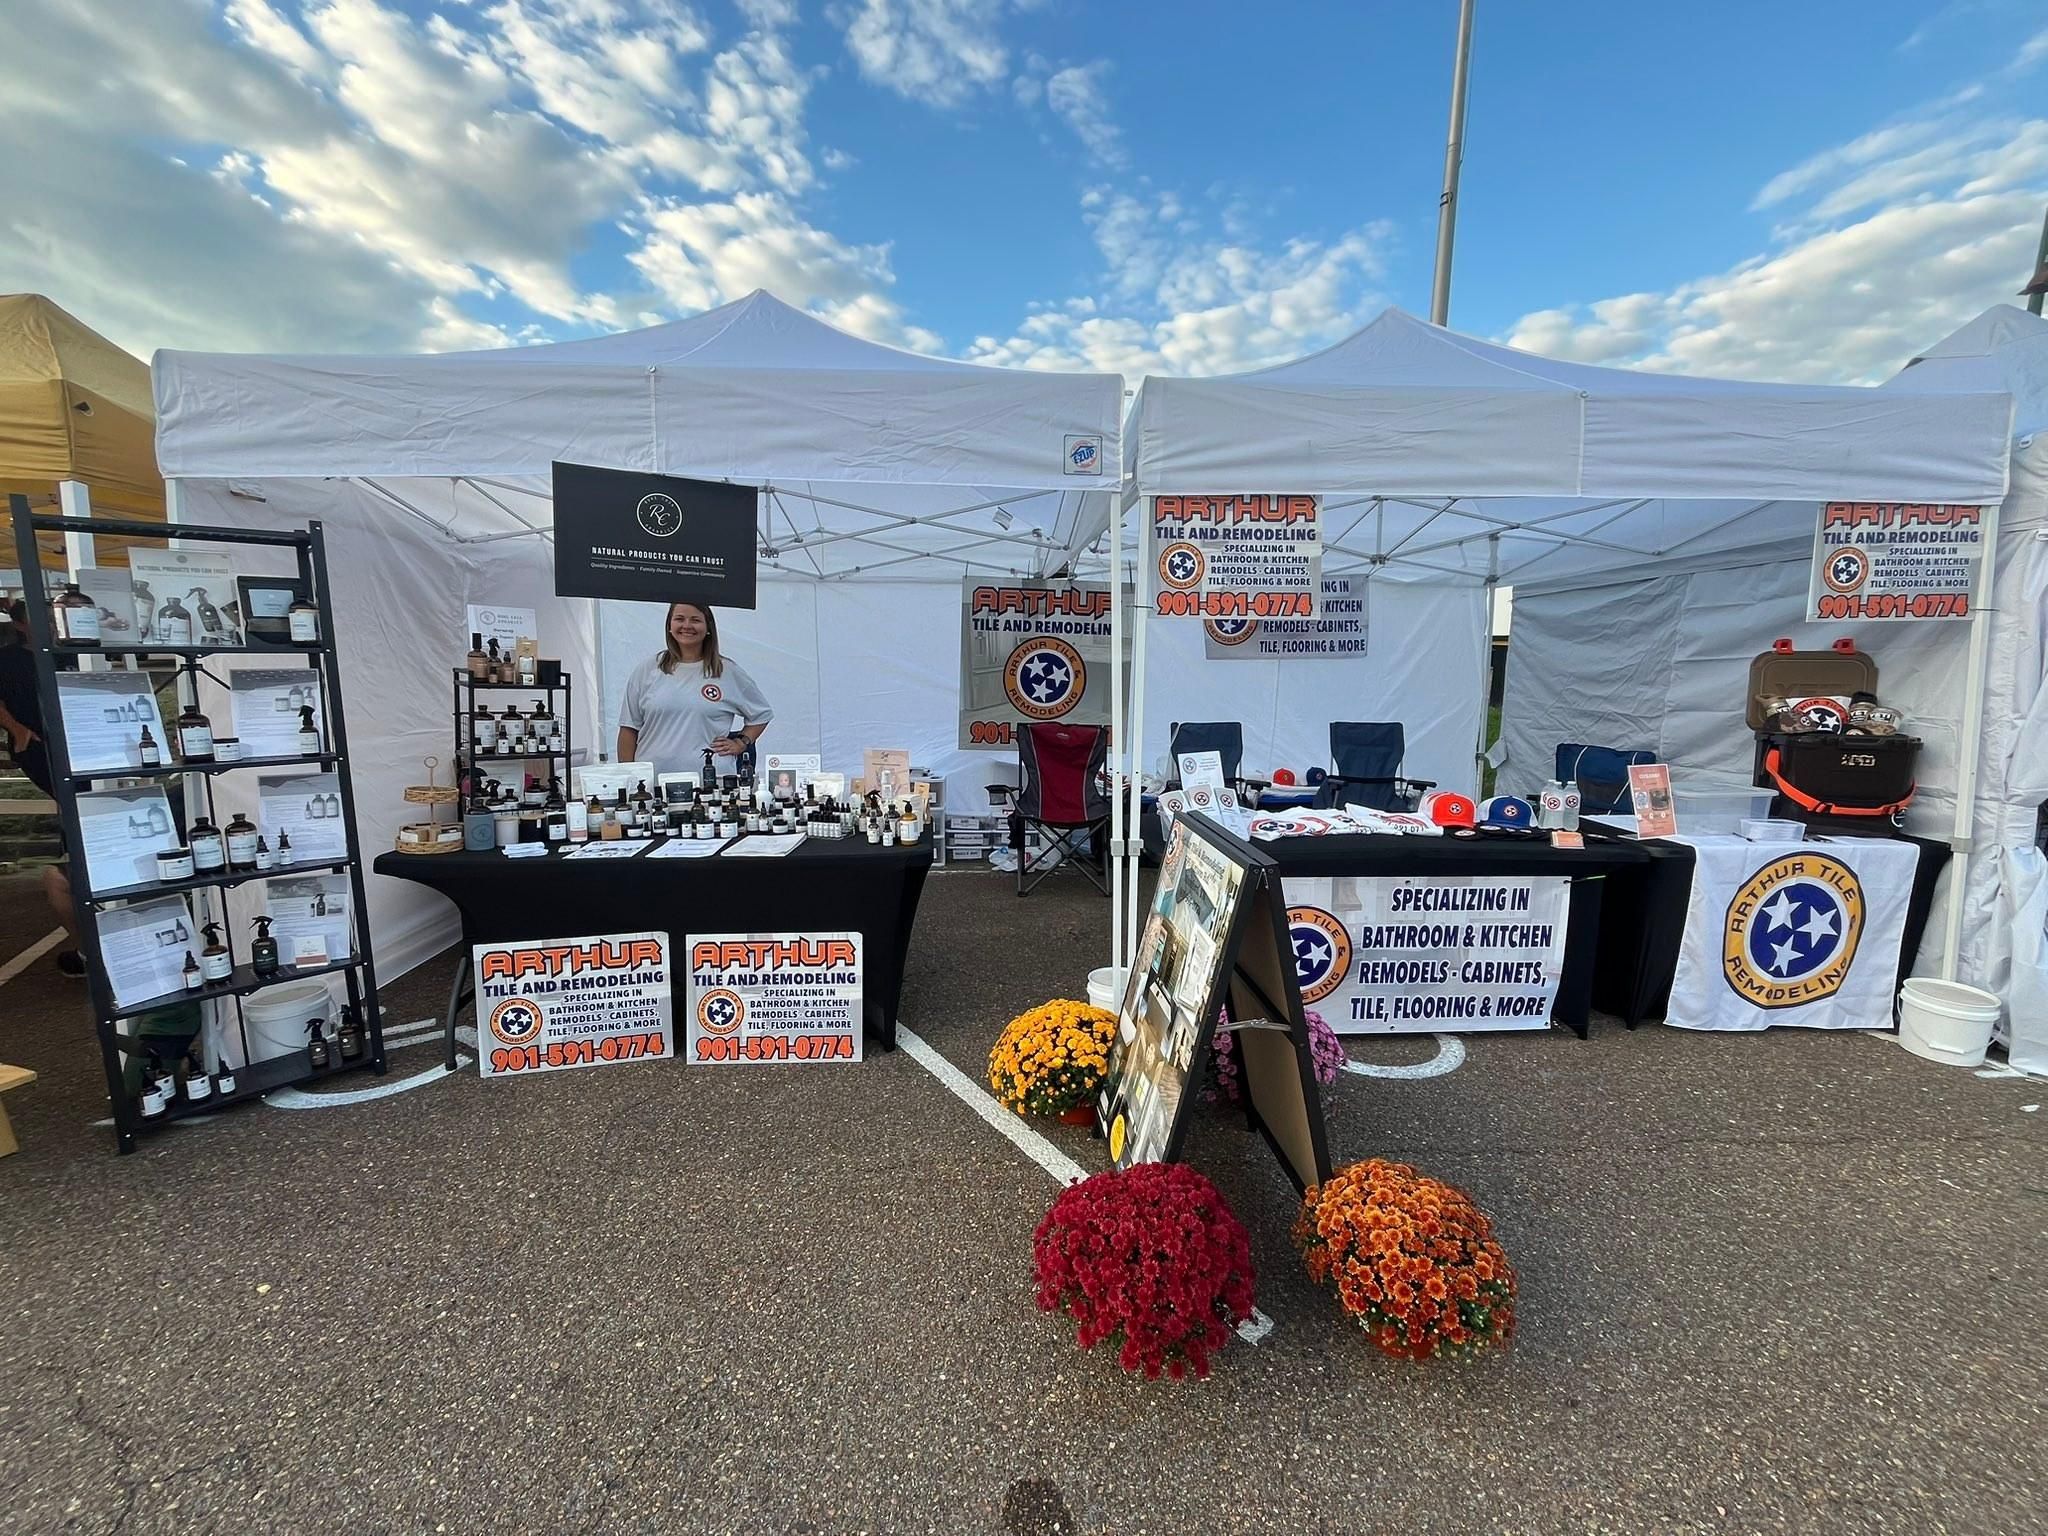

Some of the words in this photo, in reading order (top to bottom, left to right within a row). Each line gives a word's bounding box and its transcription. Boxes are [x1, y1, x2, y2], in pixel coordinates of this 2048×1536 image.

[1155, 495, 1317, 526] ARTHUR
[1824, 502, 1981, 530] ARTHUR
[1155, 527, 1184, 539] TILE
[1189, 528, 1218, 539] AND
[1223, 528, 1316, 540] REMODELING
[1824, 533, 1851, 544] TILE
[1855, 532, 1885, 544] AND
[1888, 531, 1979, 543] REMODELING
[592, 547, 625, 556] NATURAL
[629, 550, 666, 560] PRODUCTS
[686, 555, 699, 563] CAN
[703, 557, 724, 565] TRUST
[1224, 545, 1283, 553] SPECIALIZING
[1889, 547, 1946, 555] SPECIALIZING
[1211, 556, 1260, 564] BATHROOM
[1263, 556, 1269, 564] &
[1272, 556, 1309, 564] KITCHEN
[1265, 567, 1308, 575] CABINETS,
[1208, 578, 1228, 586] TILE,
[1231, 578, 1274, 586] FLOORING
[1276, 578, 1282, 586] &
[1286, 578, 1311, 586] MORE
[1339, 580, 1349, 592] IN
[1157, 591, 1312, 616] 901-591-0774
[1325, 600, 1362, 612] KITCHEN
[1818, 594, 1968, 618] 901-591-0774
[973, 619, 999, 631] TILE
[1004, 620, 1031, 632] AND
[1036, 621, 1111, 635] REMODELIN
[1263, 620, 1309, 633] REMODELS
[1317, 620, 1362, 633] CABINETS,
[1260, 641, 1280, 654] TILE,
[1282, 640, 1327, 653] FLOORING
[1329, 640, 1336, 652] &
[1338, 639, 1365, 652] MORE
[1010, 642, 1048, 676] ARTHUR
[1056, 643, 1076, 662] TILE
[1009, 689, 1078, 715] REMODELING
[1392, 888, 1507, 911] SPECIALIZING
[1511, 888, 1530, 910] IN
[1732, 862, 1804, 933] ARTHUR
[1820, 864, 1856, 902] TILE
[1313, 914, 1341, 938] TILE
[1338, 946, 1346, 958] &
[1362, 926, 1457, 948] BATHROOM
[1462, 926, 1475, 947] &
[1480, 925, 1552, 948] KITCHEN
[482, 938, 662, 983] ARTHUR
[693, 936, 856, 972] ARTHUR
[693, 975, 723, 986] TILE
[727, 974, 758, 985] AND
[762, 973, 856, 985] REMODELING
[1359, 961, 1448, 984] REMODELS
[1461, 961, 1546, 987] CABINETS,
[1727, 956, 1848, 1000] REMODELING
[483, 984, 517, 997] TILE
[522, 981, 556, 994] AND
[561, 971, 664, 991] REMODELING
[564, 990, 629, 1002] SPECIALIZING
[764, 989, 824, 997] SPECIALIZING
[549, 1003, 604, 1015] BATHROOM
[618, 998, 657, 1008] KITCHEN
[750, 1000, 800, 1008] BATHROOM
[812, 999, 850, 1007] KITCHEN
[1351, 998, 1388, 1022] TILE,
[1394, 996, 1475, 1019] FLOORING
[1480, 997, 1492, 1017] &
[1496, 996, 1546, 1016] MORE
[550, 1014, 602, 1026] REMODELS
[610, 1009, 658, 1020] CABINETS,
[751, 1011, 798, 1019] REMODELS
[804, 1010, 849, 1019] CABINETS,
[548, 1028, 571, 1037] TILE,
[573, 1023, 621, 1034] FLOORING
[634, 1019, 661, 1028] MORE
[748, 1021, 769, 1030] TILE,
[771, 1021, 815, 1029] FLOORING
[491, 1032, 665, 1073] 901-591-0774
[697, 1035, 855, 1061] 901-591-0774
